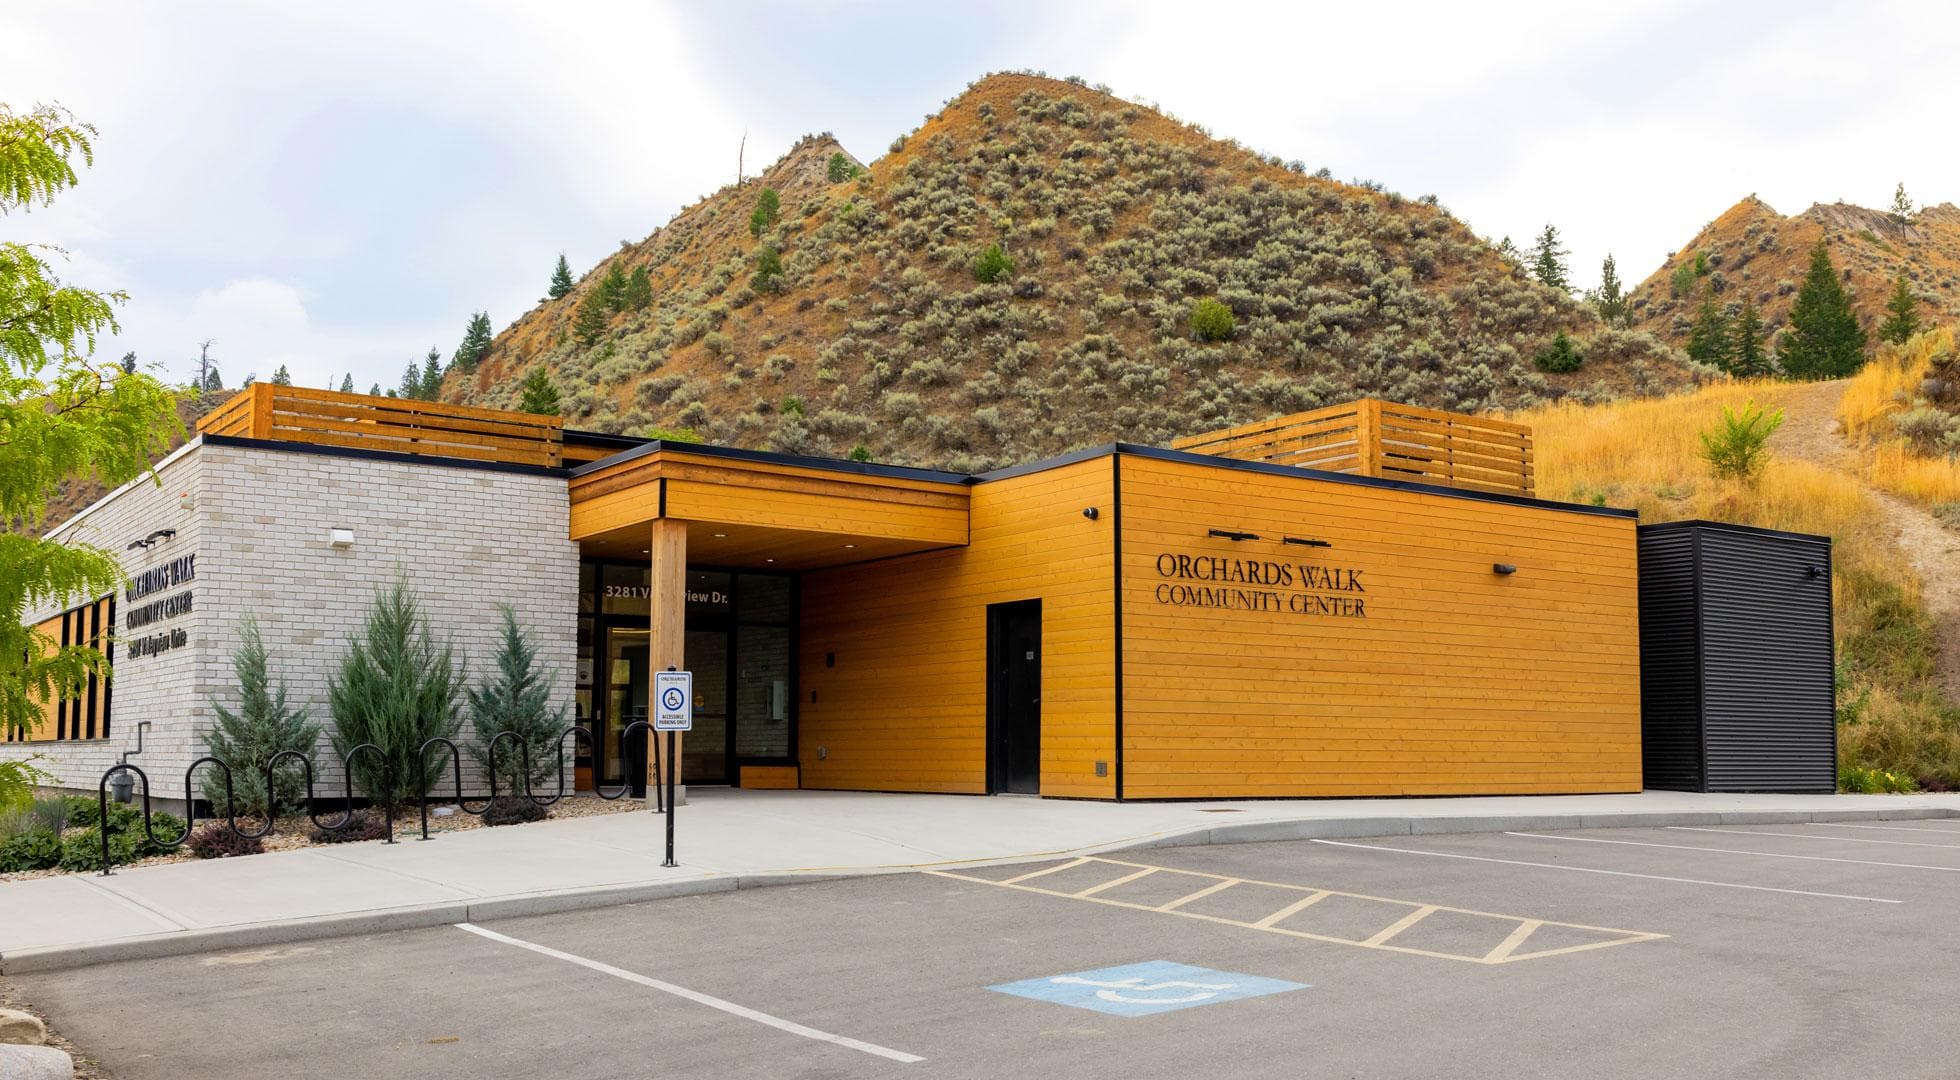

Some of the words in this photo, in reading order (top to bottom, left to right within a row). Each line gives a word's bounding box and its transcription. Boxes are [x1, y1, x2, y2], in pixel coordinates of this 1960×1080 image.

[1156, 553, 1293, 586] ORCHARDS
[1299, 565, 1365, 592] WALK
[606, 585, 637, 599] 3281
[712, 591, 728, 604] Dr.
[1156, 583, 1284, 611] COMMUNITY
[1290, 593, 1366, 617] CENTER
